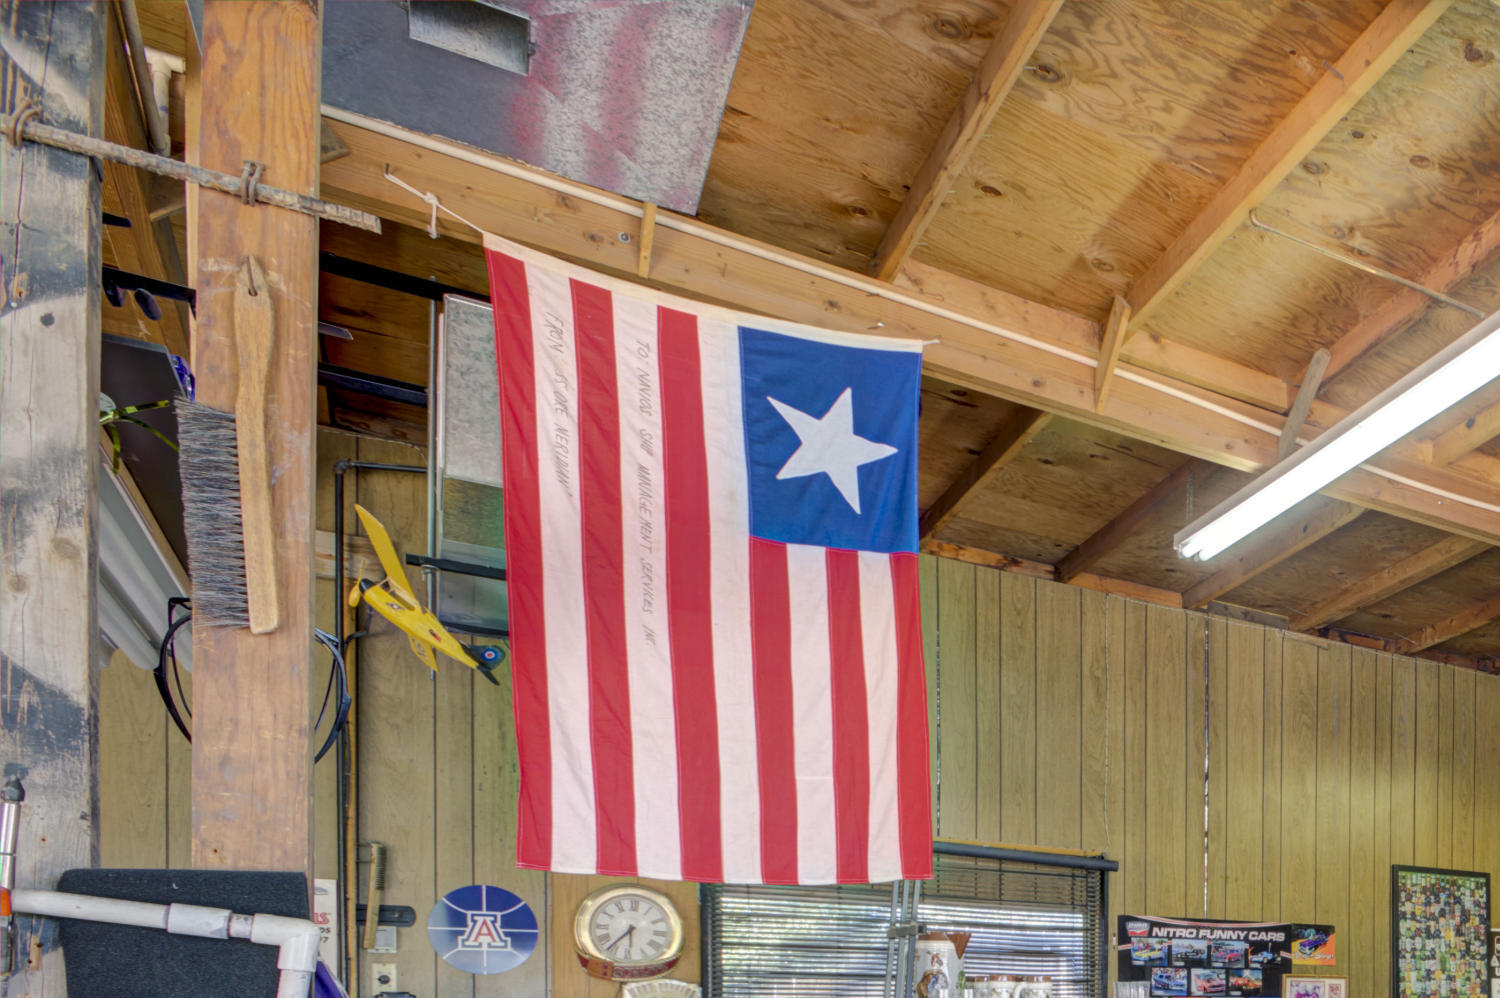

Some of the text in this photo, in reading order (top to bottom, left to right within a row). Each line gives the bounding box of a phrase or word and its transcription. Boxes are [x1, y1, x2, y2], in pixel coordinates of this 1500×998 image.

[637, 367, 652, 417] NAVIOS
[636, 461, 653, 554] MANAGEMENT
[1151, 926, 1286, 942] NITRO FUNNY CARS
